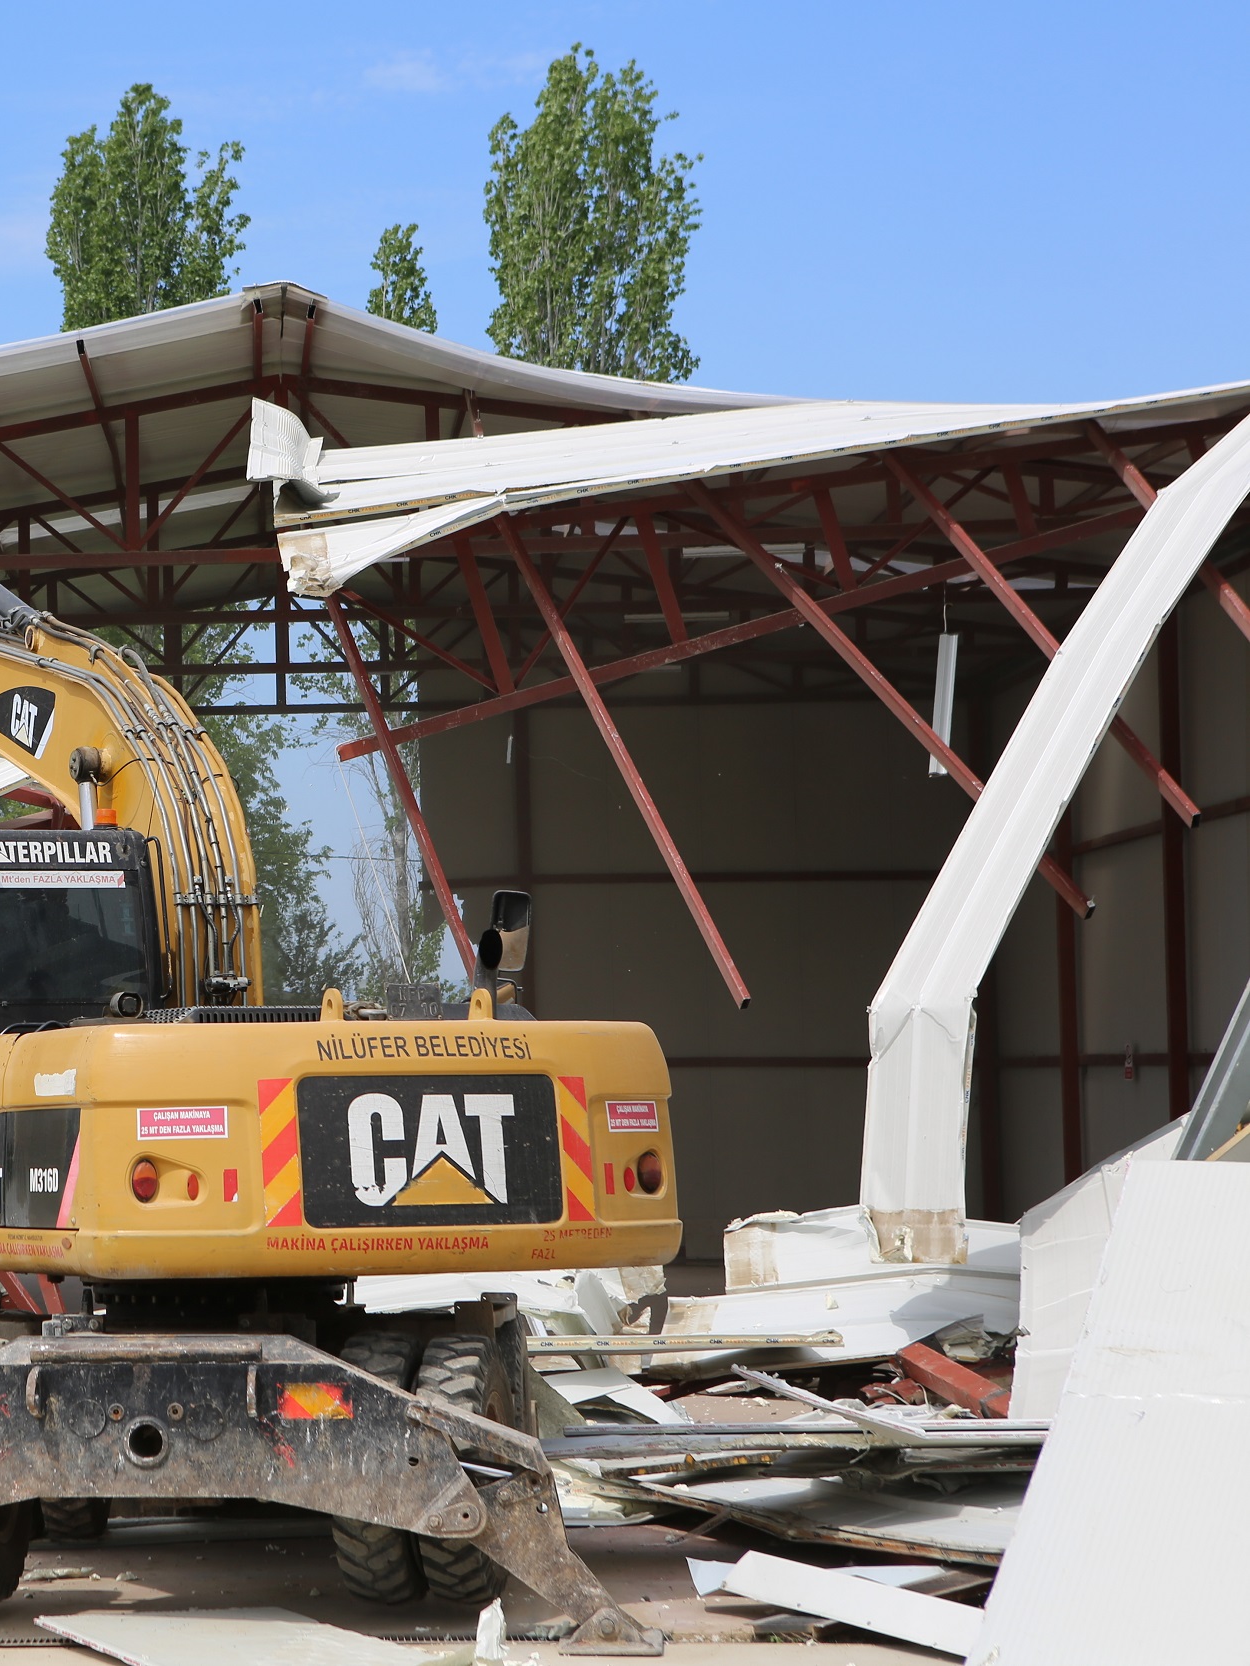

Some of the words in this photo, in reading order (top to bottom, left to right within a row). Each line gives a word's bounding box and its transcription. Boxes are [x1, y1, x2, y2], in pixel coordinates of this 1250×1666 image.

[429, 530, 442, 538] CHK
[11, 694, 38, 748] CAT
[65, 875, 116, 884] YAKLAŞMA
[316, 1033, 411, 1061] NİLÜFER
[414, 1032, 532, 1060] BELEDİYESİ
[154, 1112, 178, 1121] ÇALIŞAN
[180, 1109, 210, 1119] MAKİNAYA
[141, 1126, 148, 1134] 25
[150, 1126, 158, 1134] MT
[160, 1126, 171, 1134] DEN
[173, 1125, 190, 1133] FAZLA
[192, 1124, 224, 1134] YAKLAŞMA
[348, 1092, 515, 1206] CAT
[30, 1168, 58, 1192] M316D
[544, 1230, 555, 1241] 25
[266, 1234, 326, 1250] MAKİNA
[331, 1237, 413, 1253] ÇALIŞIRKEN
[418, 1236, 488, 1253] YAKLAŞMA
